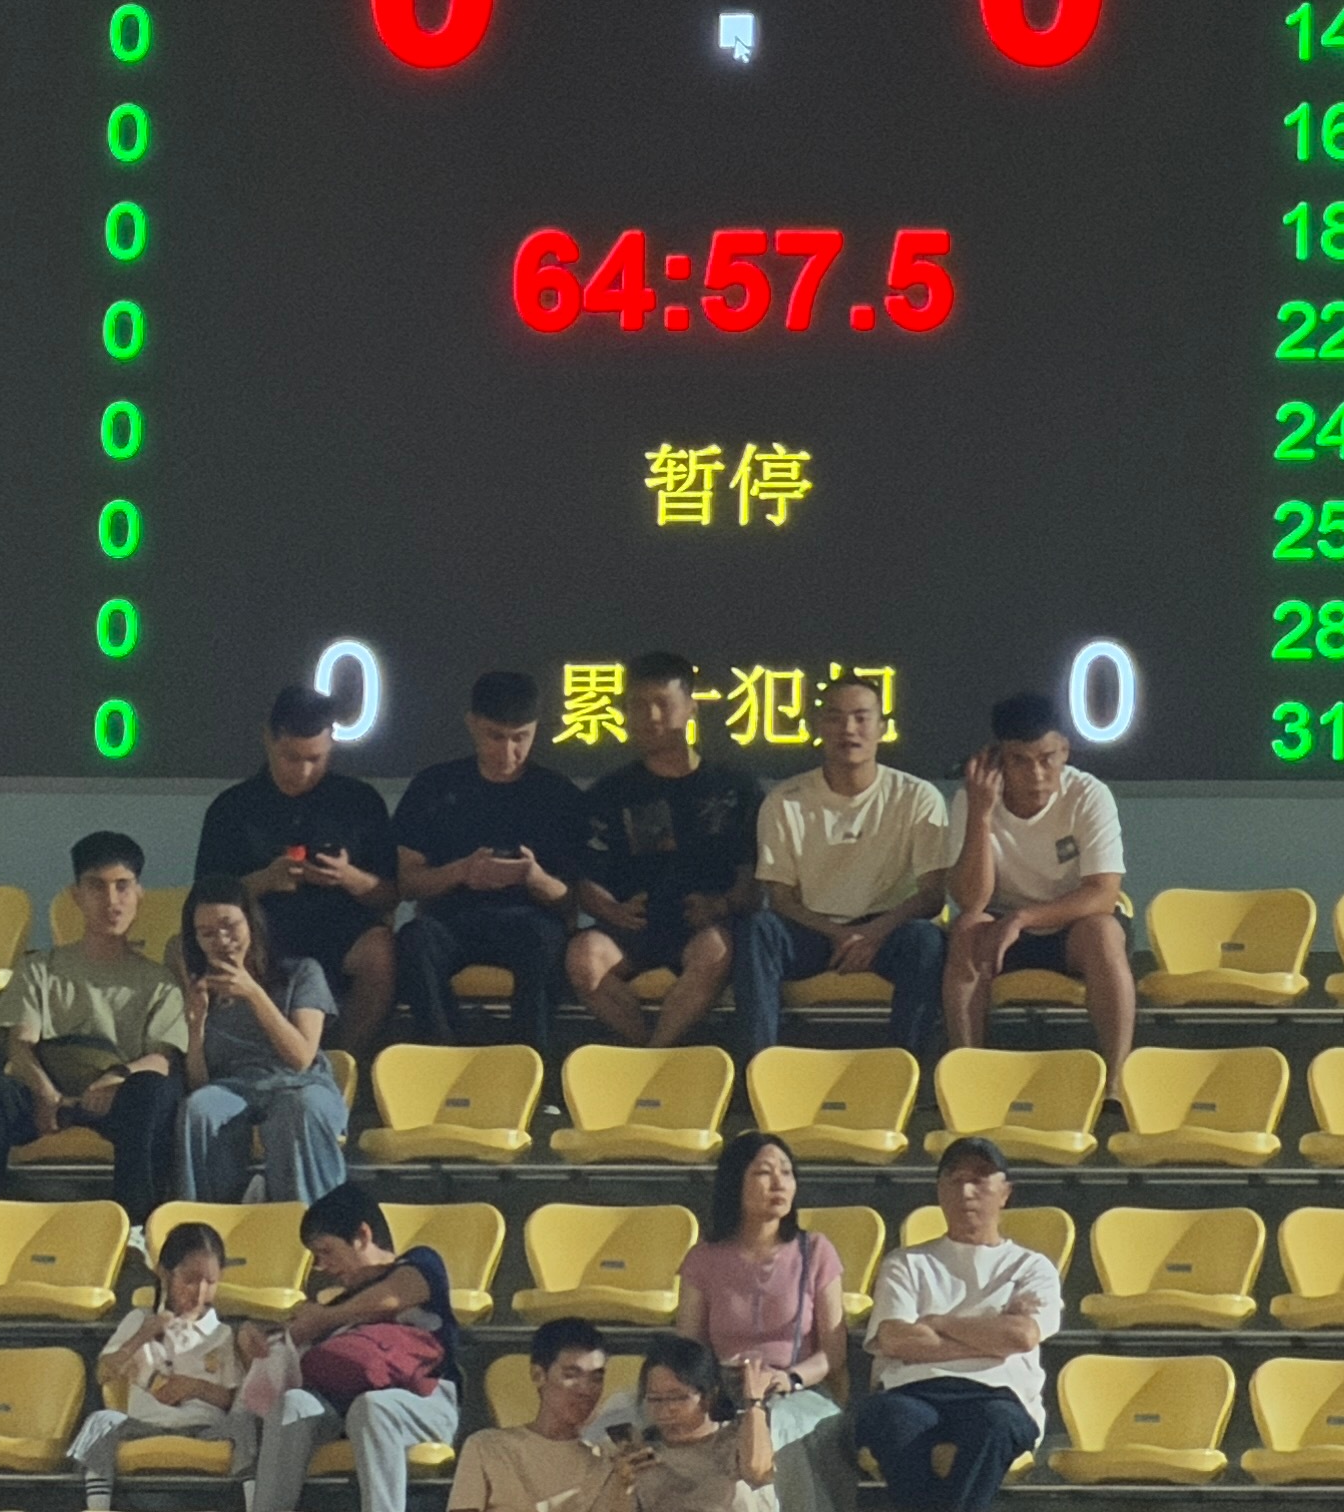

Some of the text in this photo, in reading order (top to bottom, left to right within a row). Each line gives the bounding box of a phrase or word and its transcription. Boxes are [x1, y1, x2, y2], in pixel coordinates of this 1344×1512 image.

[110, 4, 151, 63] 0
[108, 103, 149, 162] 0
[105, 201, 146, 261] 0
[512, 228, 955, 334] 64:57.5
[103, 300, 145, 360] 0
[101, 401, 142, 460] 0
[645, 443, 812, 526] 暂停
[99, 499, 141, 558] 0
[97, 599, 139, 658] 0
[314, 640, 382, 742] 0
[1069, 641, 1137, 743] 0
[95, 699, 138, 759] 0
